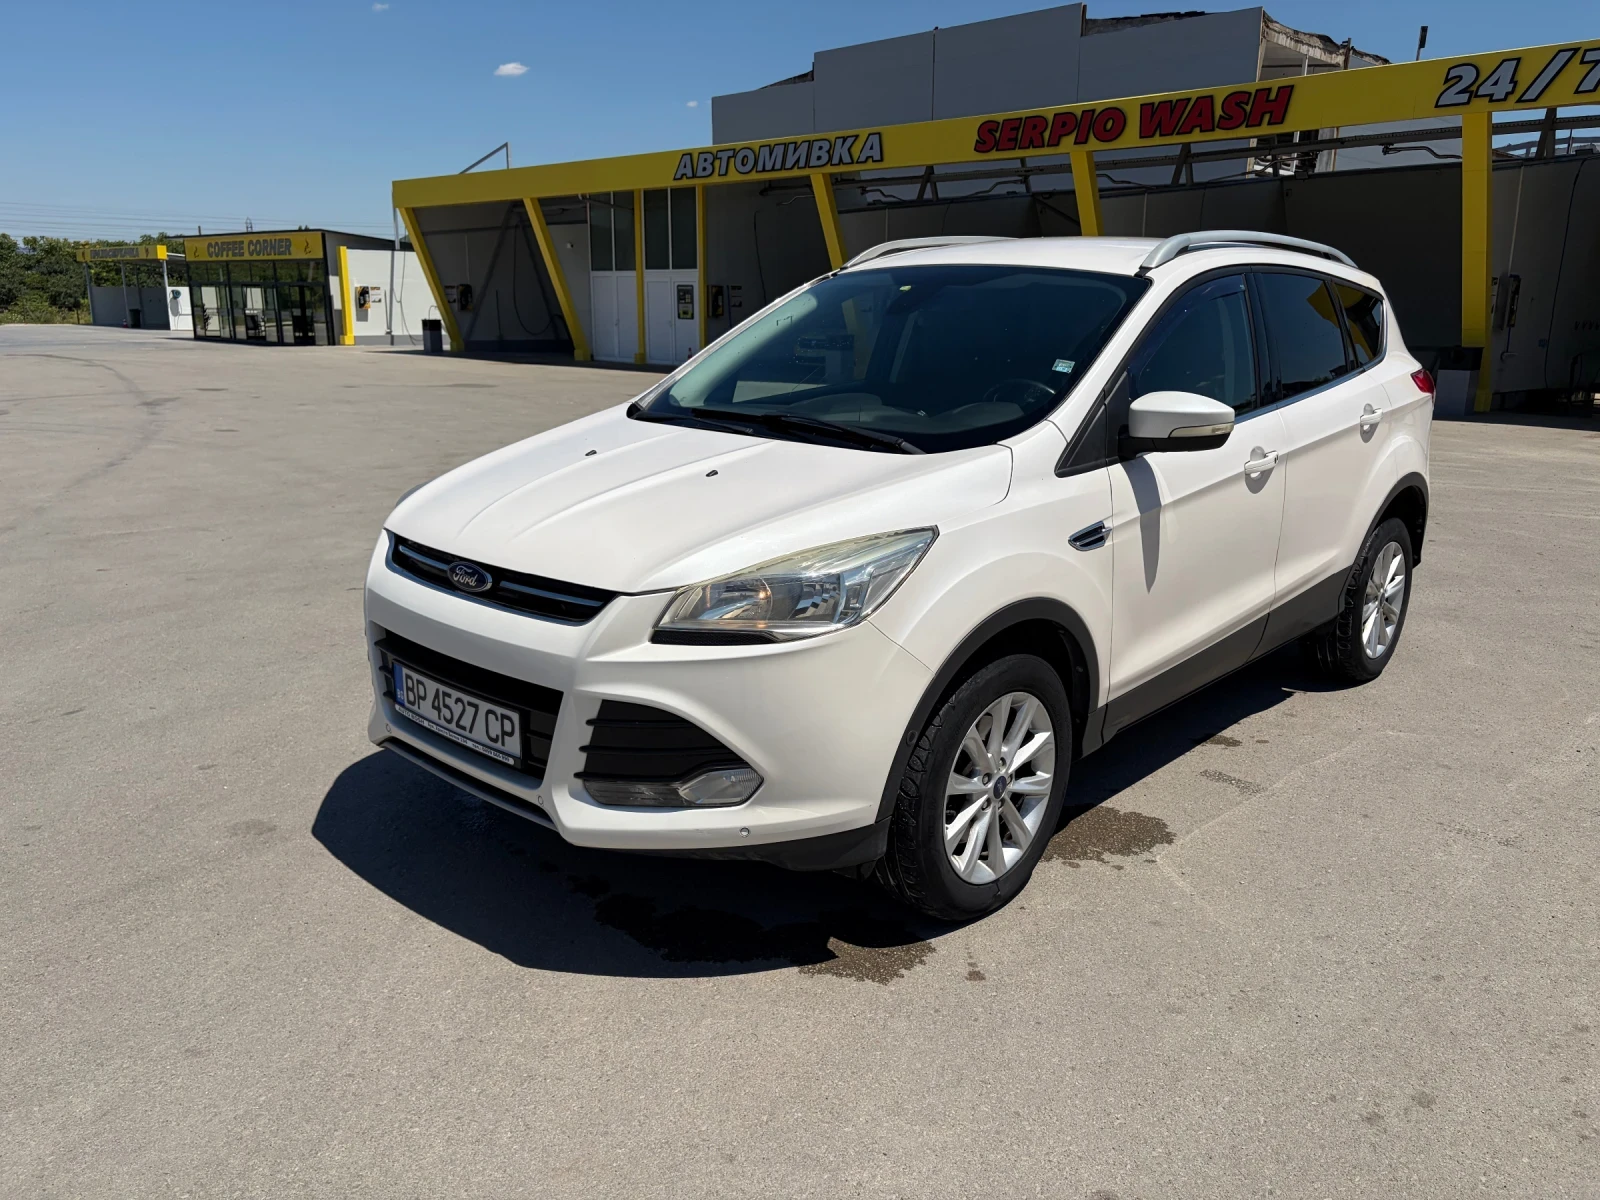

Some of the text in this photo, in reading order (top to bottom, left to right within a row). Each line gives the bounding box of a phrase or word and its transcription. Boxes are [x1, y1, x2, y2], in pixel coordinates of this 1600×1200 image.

[1434, 47, 1600, 108] 24/7
[974, 84, 1294, 153] SERPIO WASH
[673, 132, 884, 181] АВТОМИВКА
[207, 238, 292, 258] COFFEE CORNER
[452, 565, 479, 587] Ford
[431, 687, 480, 735] 4527
